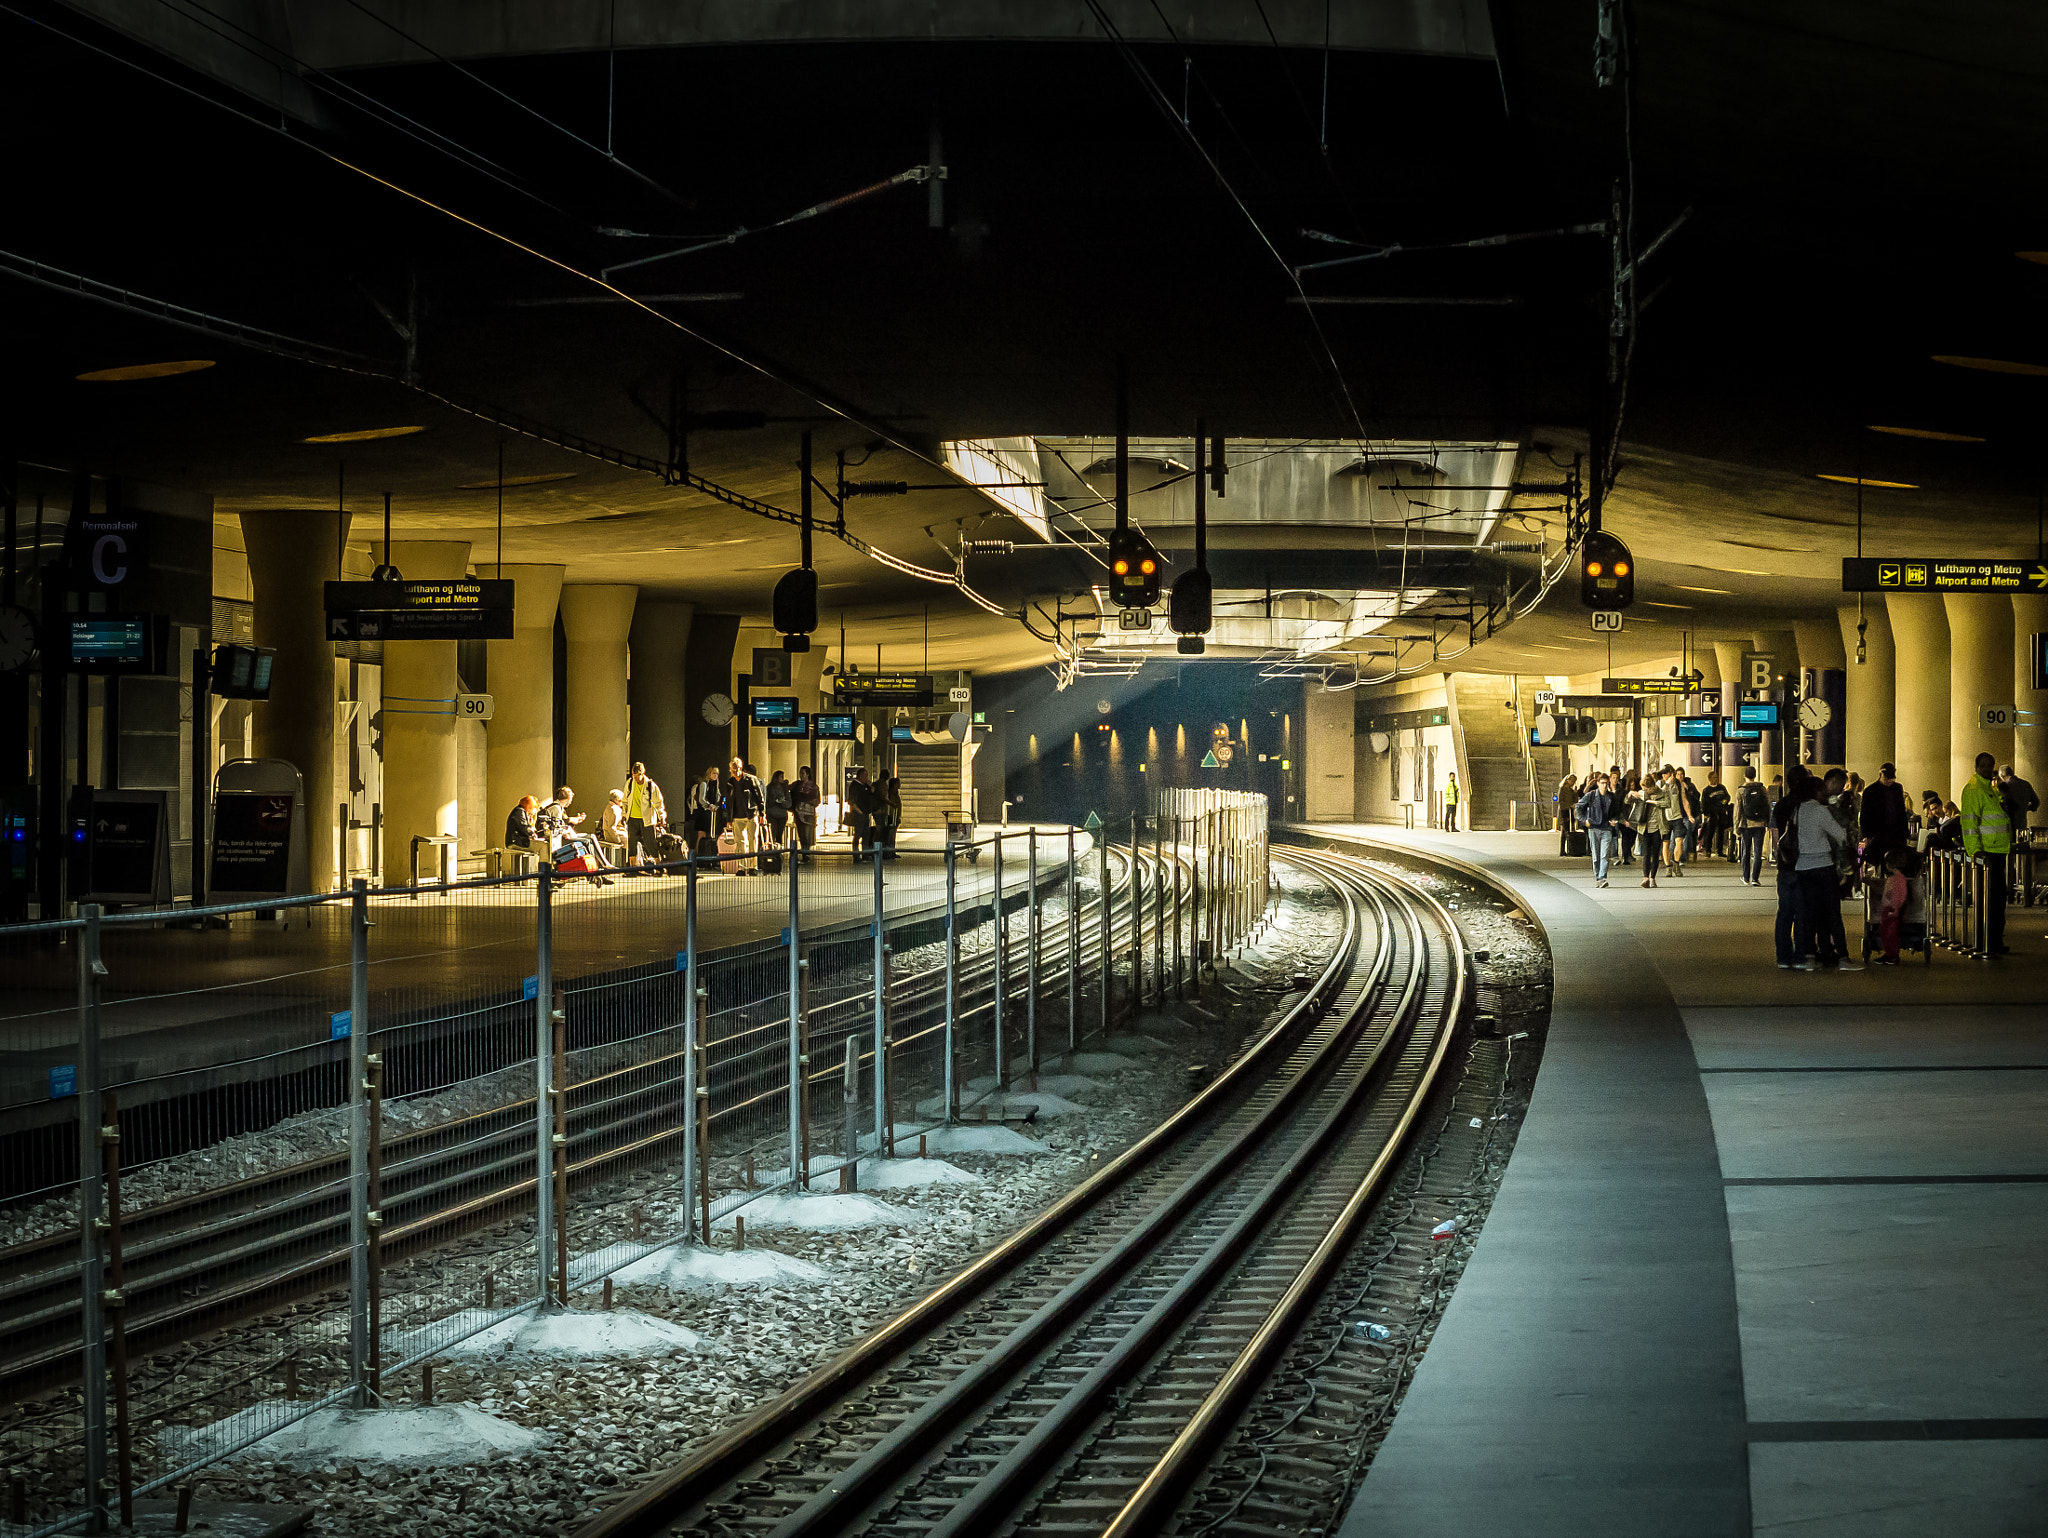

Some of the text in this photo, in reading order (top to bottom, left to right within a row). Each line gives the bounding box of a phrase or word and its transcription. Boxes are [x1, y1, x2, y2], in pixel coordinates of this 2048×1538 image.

[92, 534, 128, 584] C
[1935, 564, 2022, 576] Lufthavn og Metro
[1935, 576, 2020, 587] Airport and Metro
[404, 584, 481, 595] Lufthavn og Metro
[434, 595, 452, 603] and
[453, 595, 479, 603] Metro
[1123, 612, 1148, 627] PU
[1594, 614, 1619, 629] PU
[763, 656, 783, 684] B
[1751, 660, 1771, 689] B
[951, 691, 968, 699] 180
[1538, 692, 1554, 701] 180
[465, 700, 485, 715] 90
[1987, 710, 2006, 724] 90
